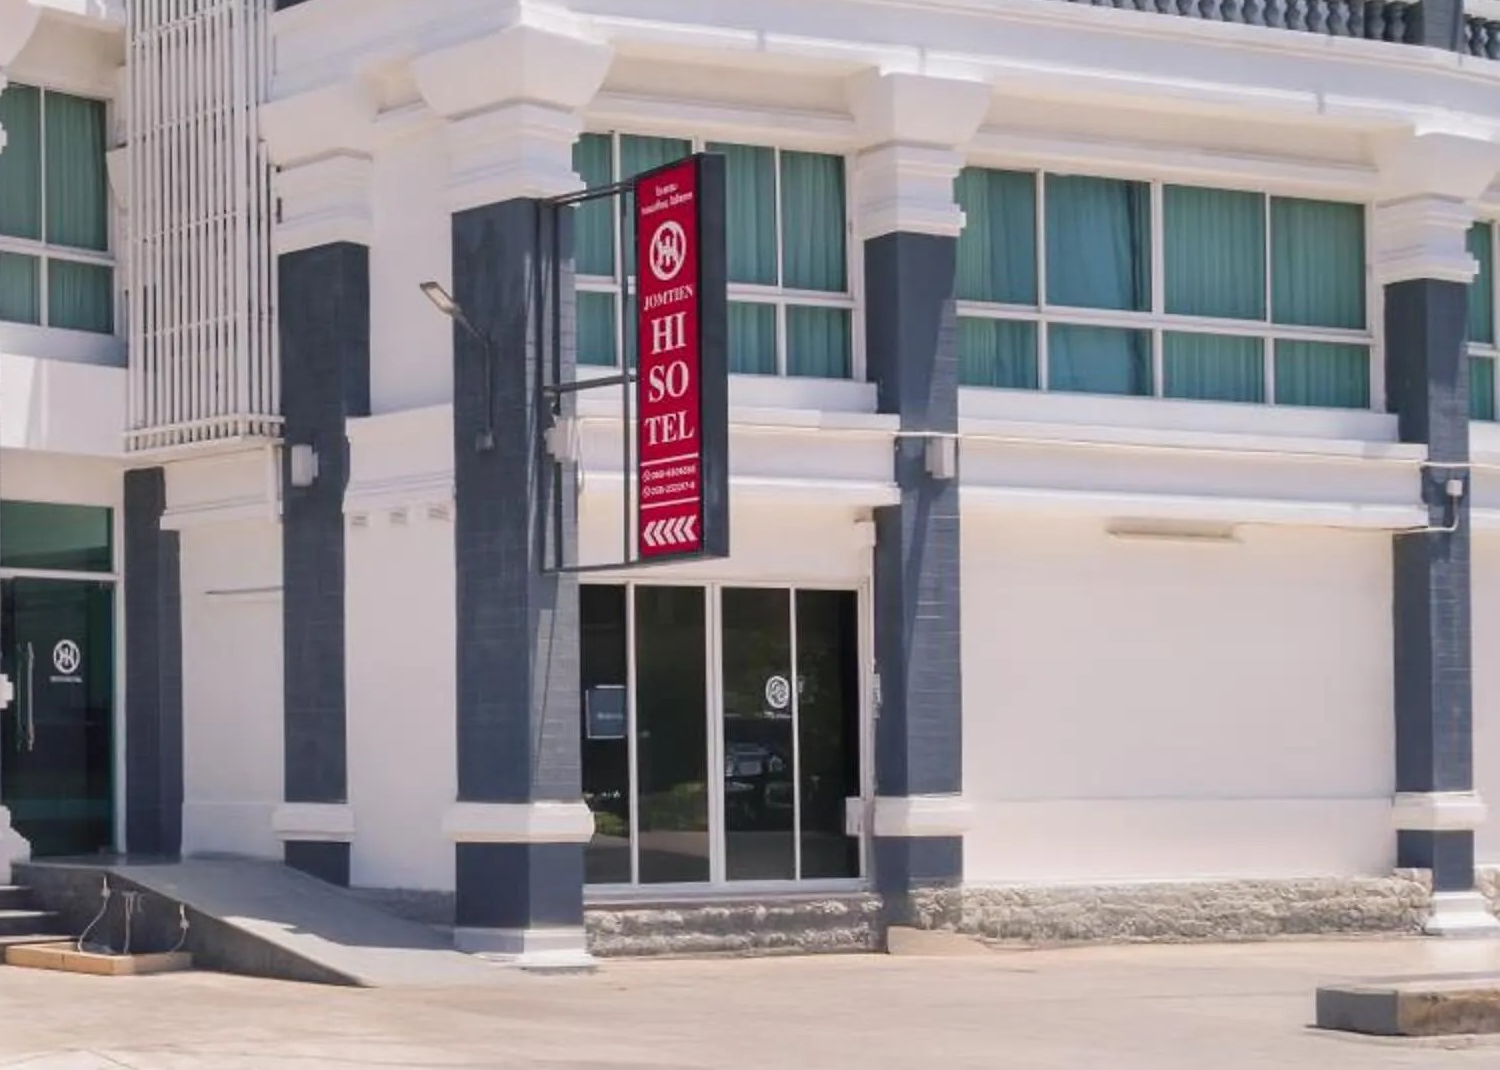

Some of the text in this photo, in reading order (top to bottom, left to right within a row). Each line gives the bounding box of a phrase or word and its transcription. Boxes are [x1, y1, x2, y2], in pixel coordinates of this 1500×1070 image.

[643, 284, 693, 311] JOMTIEN
[651, 311, 687, 355] HI
[649, 361, 689, 403] SO
[645, 410, 695, 446] TEL
